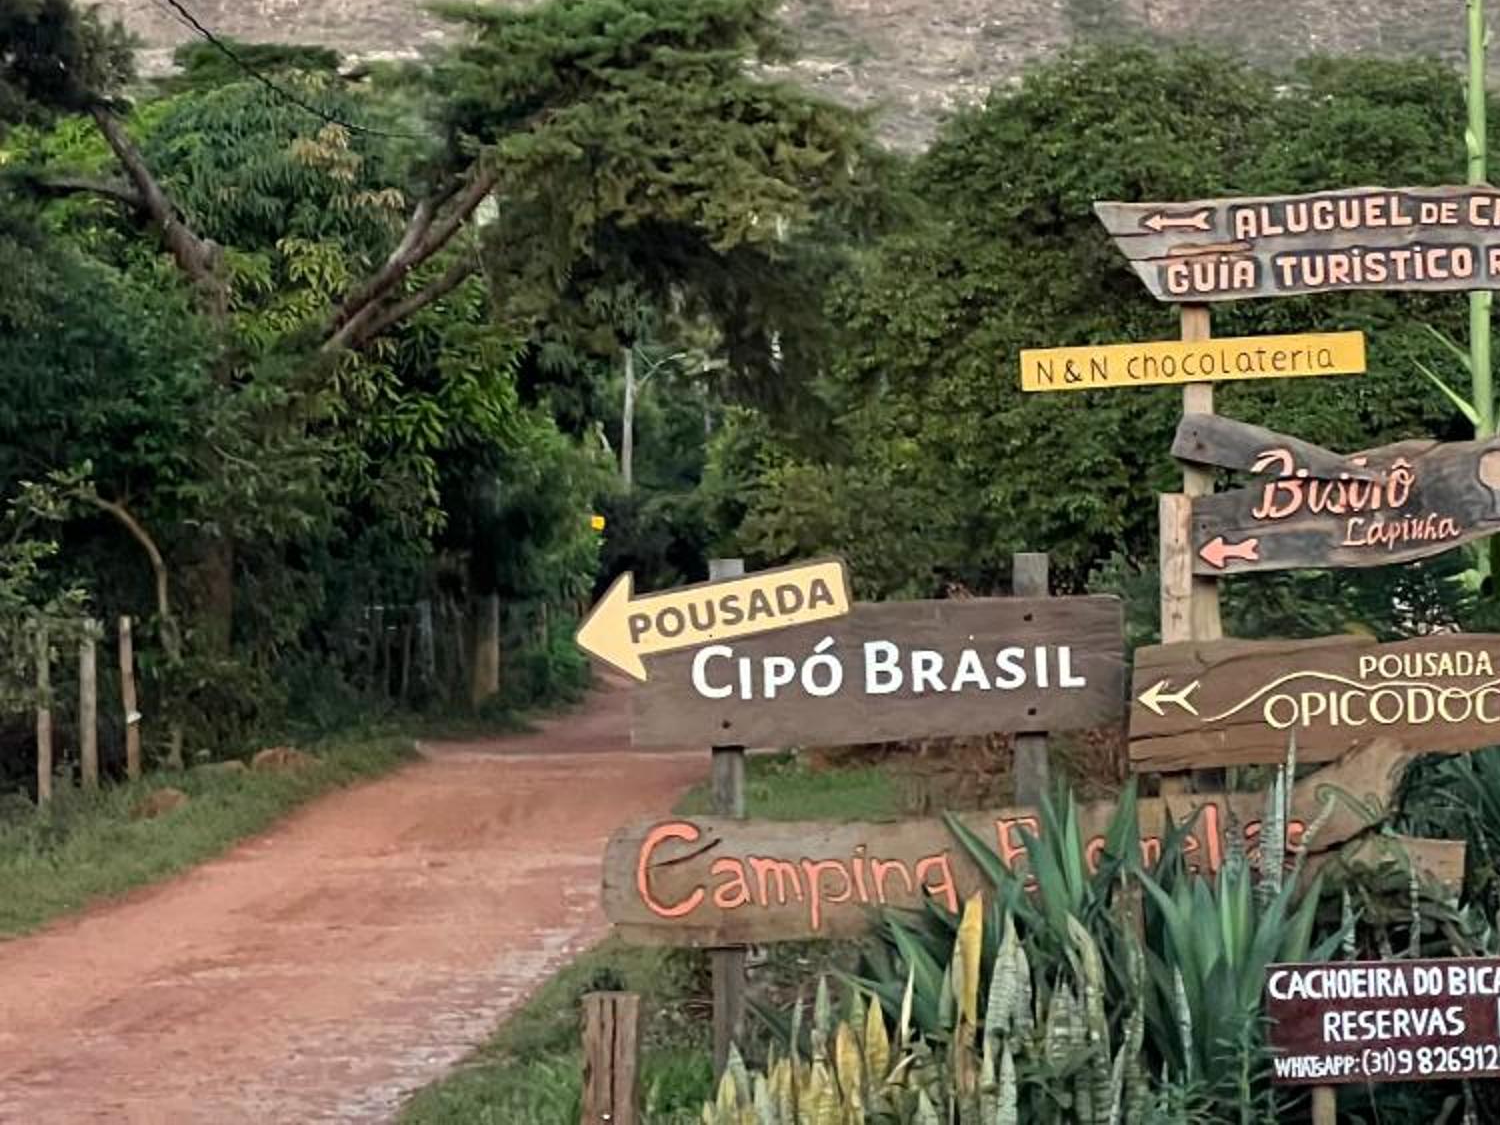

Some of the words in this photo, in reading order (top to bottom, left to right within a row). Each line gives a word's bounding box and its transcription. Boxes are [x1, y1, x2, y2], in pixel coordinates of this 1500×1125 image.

[1235, 196, 1413, 239] ALUGUEL
[1420, 202, 1458, 224] DE
[1127, 347, 1336, 379] chocolateria
[1341, 512, 1460, 549] Lapinha
[628, 578, 834, 644] POUSADA
[1359, 650, 1494, 679] POUSADA
[1269, 971, 1409, 1000] CACHOEIRA
[1413, 968, 1443, 996] DO
[1323, 1006, 1466, 1042] RESERVAS
